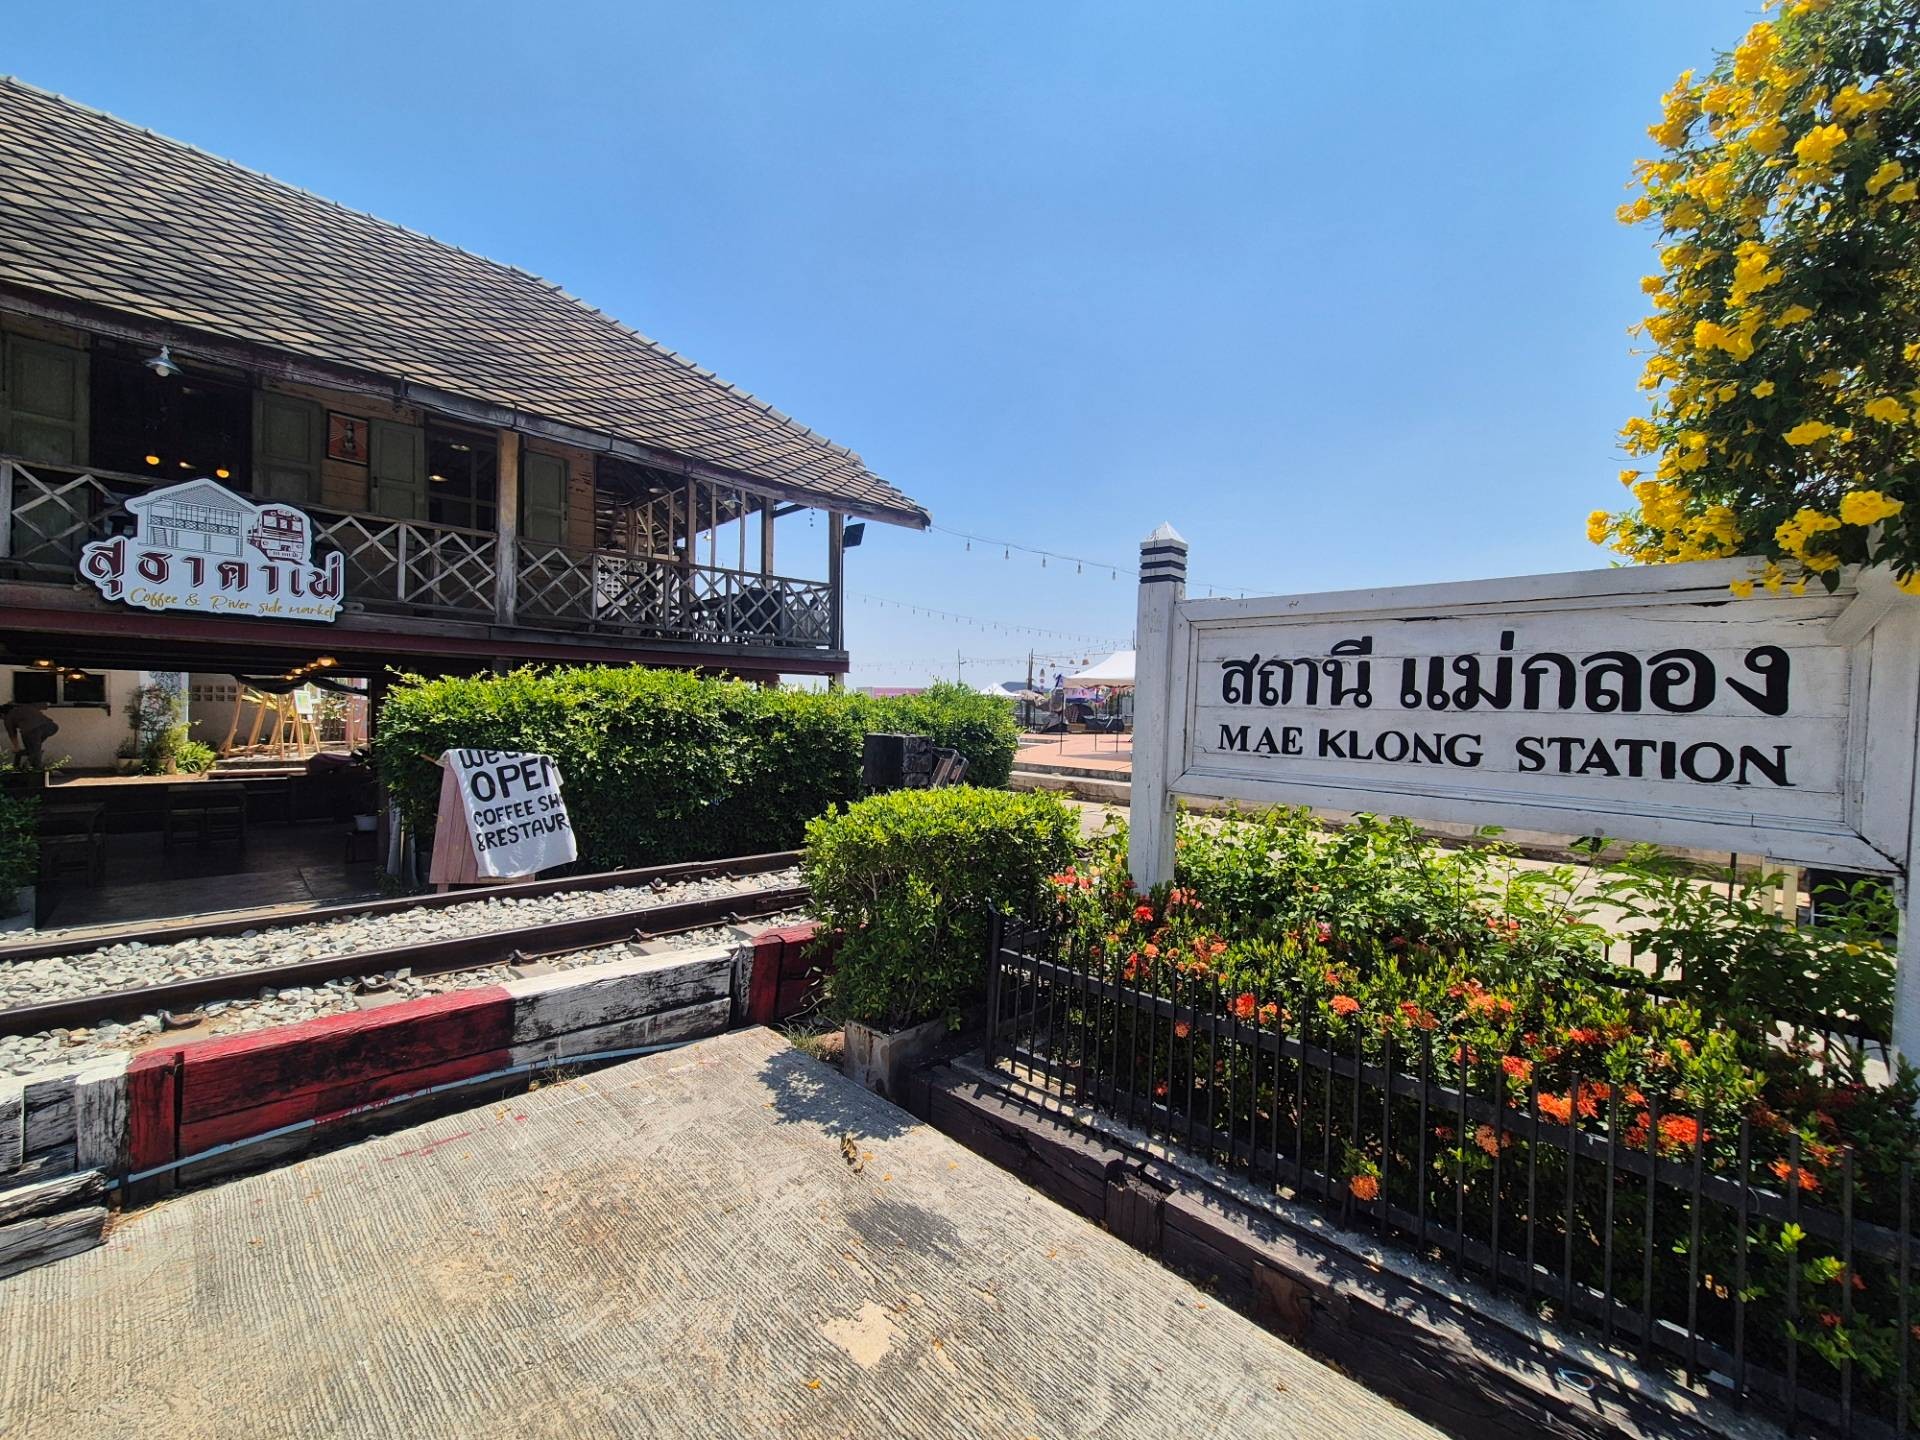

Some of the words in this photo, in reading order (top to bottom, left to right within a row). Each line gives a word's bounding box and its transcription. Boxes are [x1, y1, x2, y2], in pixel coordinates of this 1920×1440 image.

[130, 586, 178, 608] Coffee
[185, 592, 201, 606] &
[209, 594, 252, 610] River
[1220, 635, 1374, 708] สถานี
[1401, 630, 1791, 716] แม่กลอง
[1218, 724, 1304, 756] MAE
[1317, 729, 1484, 768] KLONG
[1515, 736, 1797, 788] STATION
[473, 800, 536, 828] COFFEE
